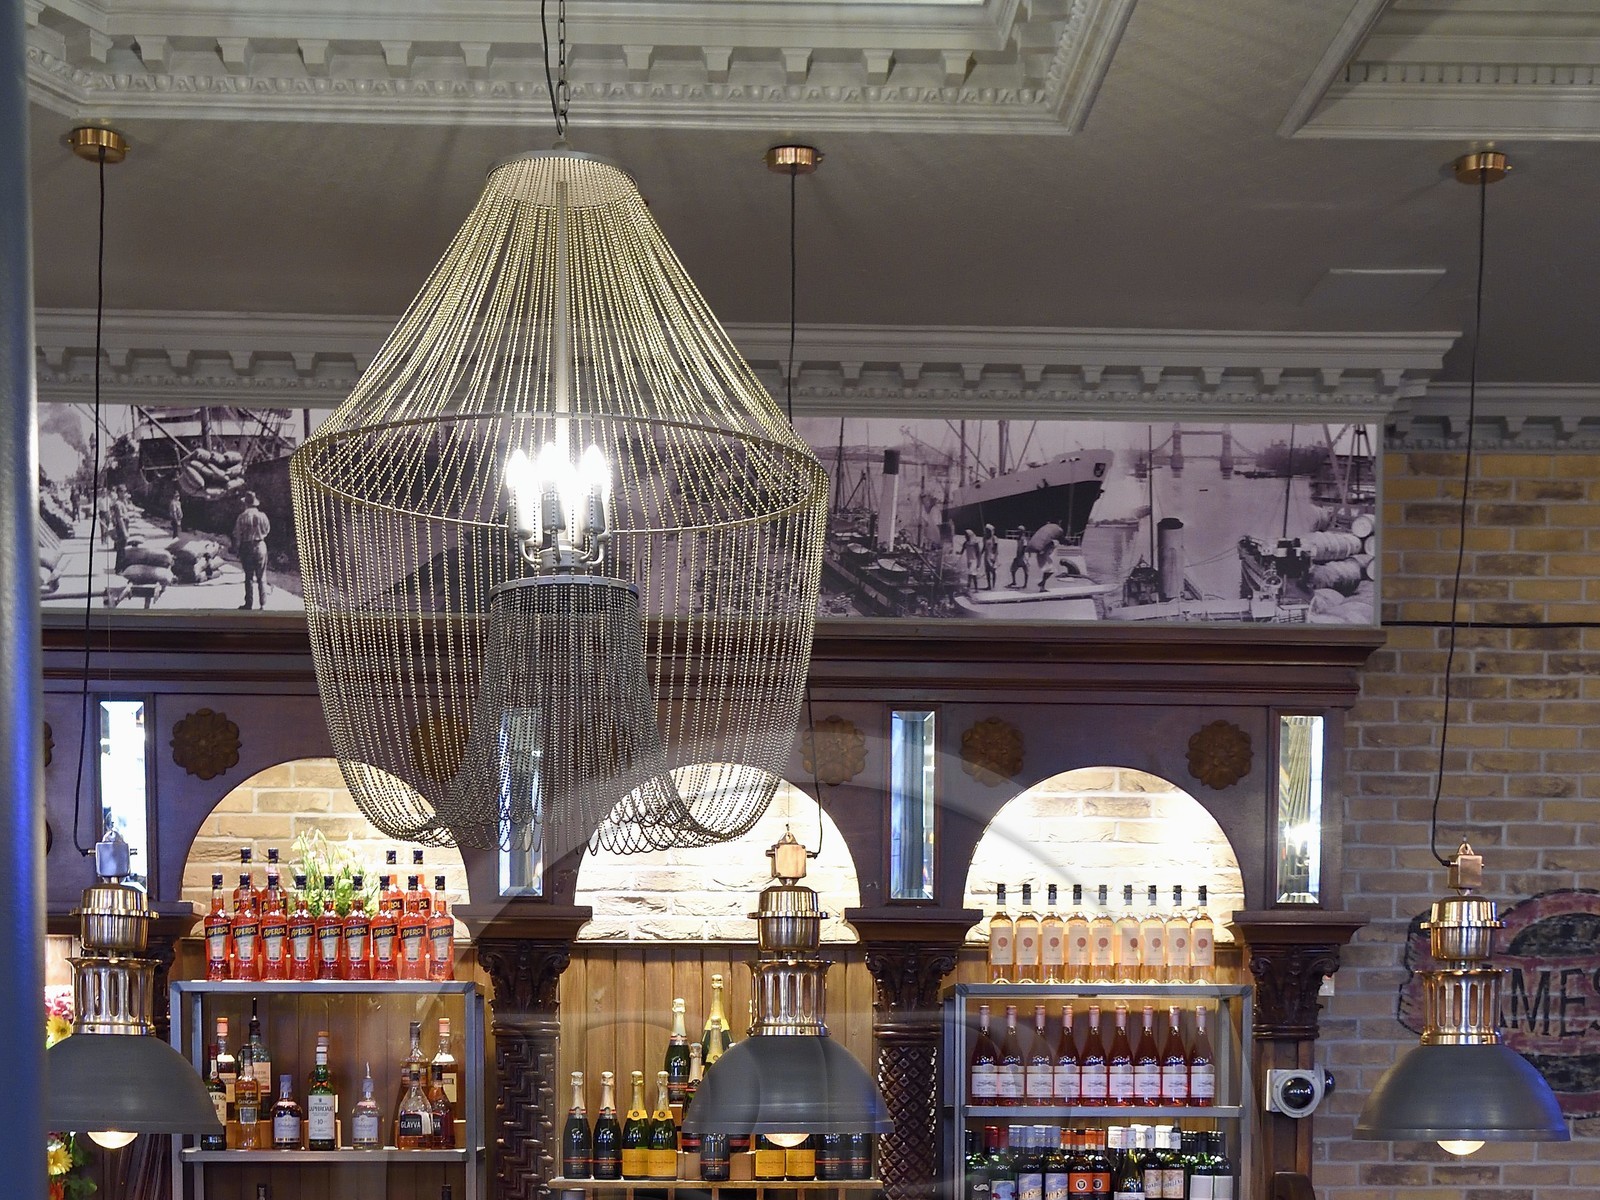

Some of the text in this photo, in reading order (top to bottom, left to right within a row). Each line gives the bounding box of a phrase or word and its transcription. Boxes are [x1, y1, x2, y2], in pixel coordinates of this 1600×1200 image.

[207, 928, 229, 937] APEROL
[235, 928, 257, 937] APEROL
[263, 929, 286, 937] APEROL
[291, 928, 313, 937] APEROL
[319, 928, 341, 937] APEROL
[345, 928, 367, 937] APEROL
[374, 928, 396, 937] APEROL
[402, 927, 424, 936] APEROL
[431, 928, 453, 937] APEROL
[400, 1120, 421, 1129] GLAYVA
